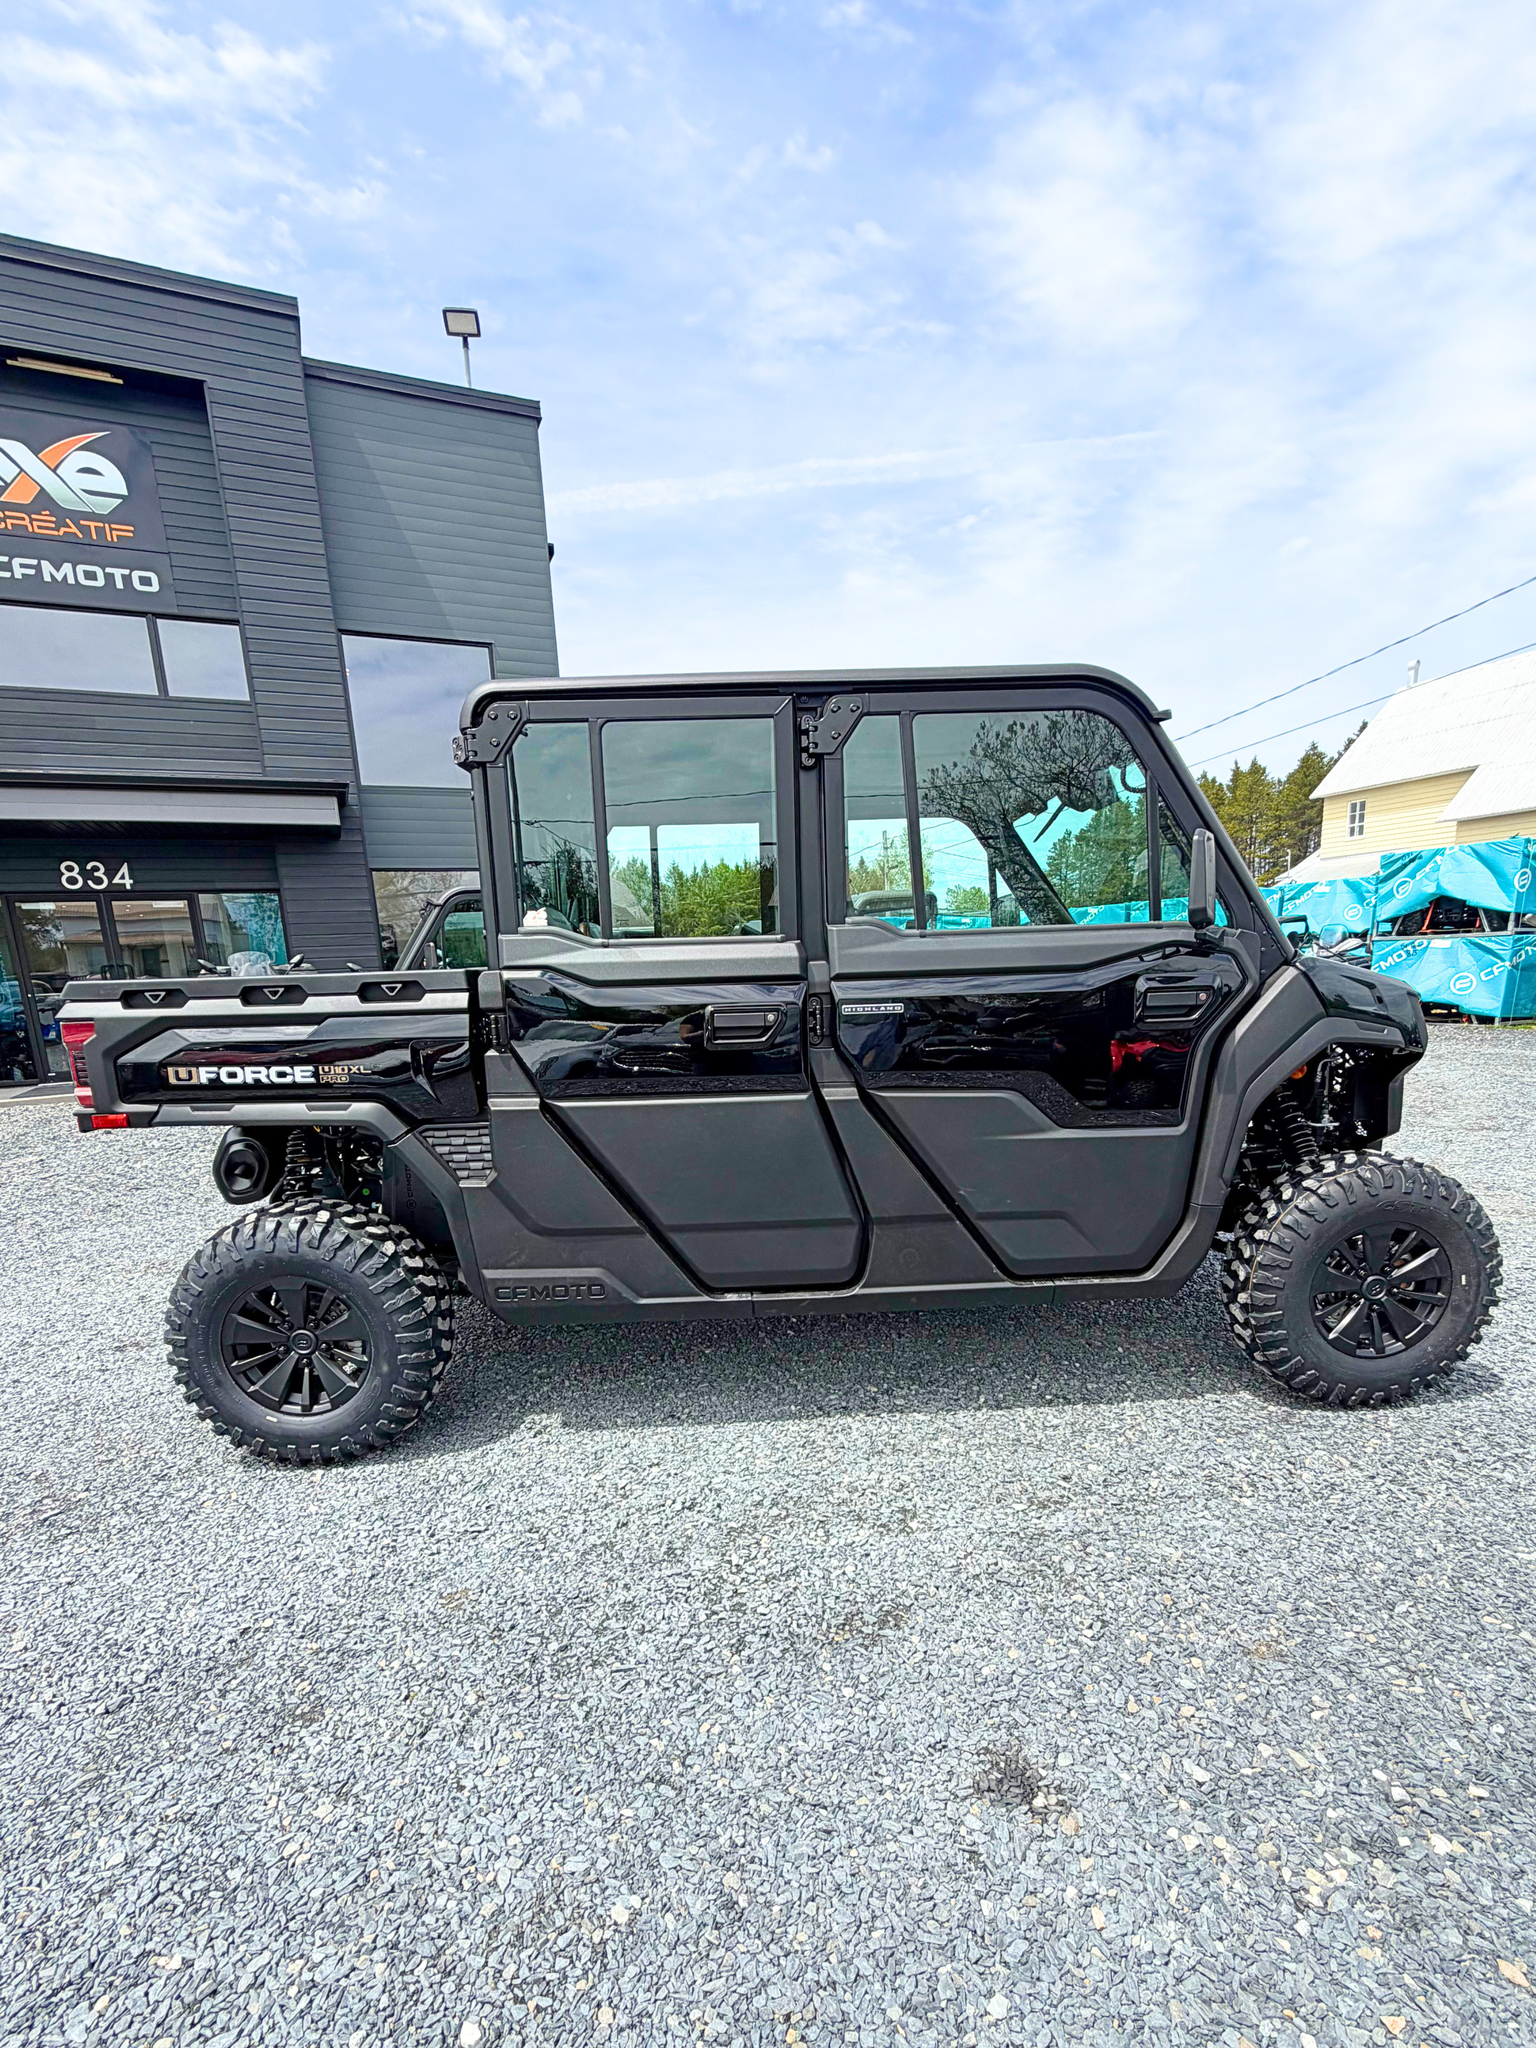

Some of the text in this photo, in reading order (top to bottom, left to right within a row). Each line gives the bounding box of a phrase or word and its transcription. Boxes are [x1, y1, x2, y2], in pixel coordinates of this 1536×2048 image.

[0, 511, 134, 542] RÉATIF
[60, 861, 133, 890] 834
[1371, 939, 1428, 973] FMOTO
[844, 1005, 902, 1013] HIGHLAND
[320, 1075, 349, 1084] PRO
[405, 1164, 414, 1198] CFMOT
[494, 1283, 606, 1302] CFMOTO
